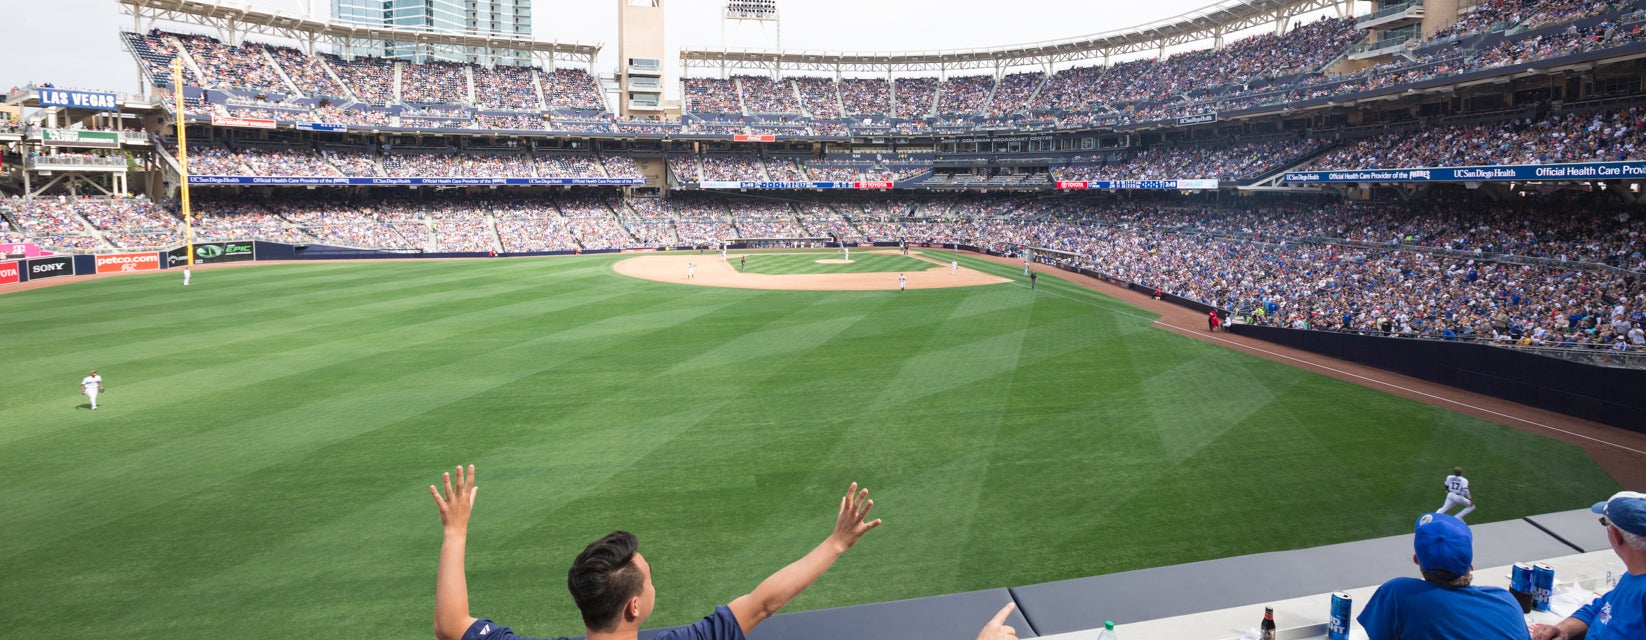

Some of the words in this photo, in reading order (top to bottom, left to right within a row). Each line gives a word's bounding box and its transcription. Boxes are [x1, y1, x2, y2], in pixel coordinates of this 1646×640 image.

[42, 91, 69, 105] LAS
[71, 92, 115, 108] VEGAS
[1454, 170, 1464, 178] UC
[1476, 169, 1494, 178] Diego
[1494, 169, 1516, 177] Health
[1536, 168, 1565, 176] Official
[1567, 166, 1596, 176] Health
[1598, 166, 1620, 175] Care
[98, 255, 157, 266] petco.com
[32, 263, 65, 273] SONY
[1452, 482, 1460, 490] 17
